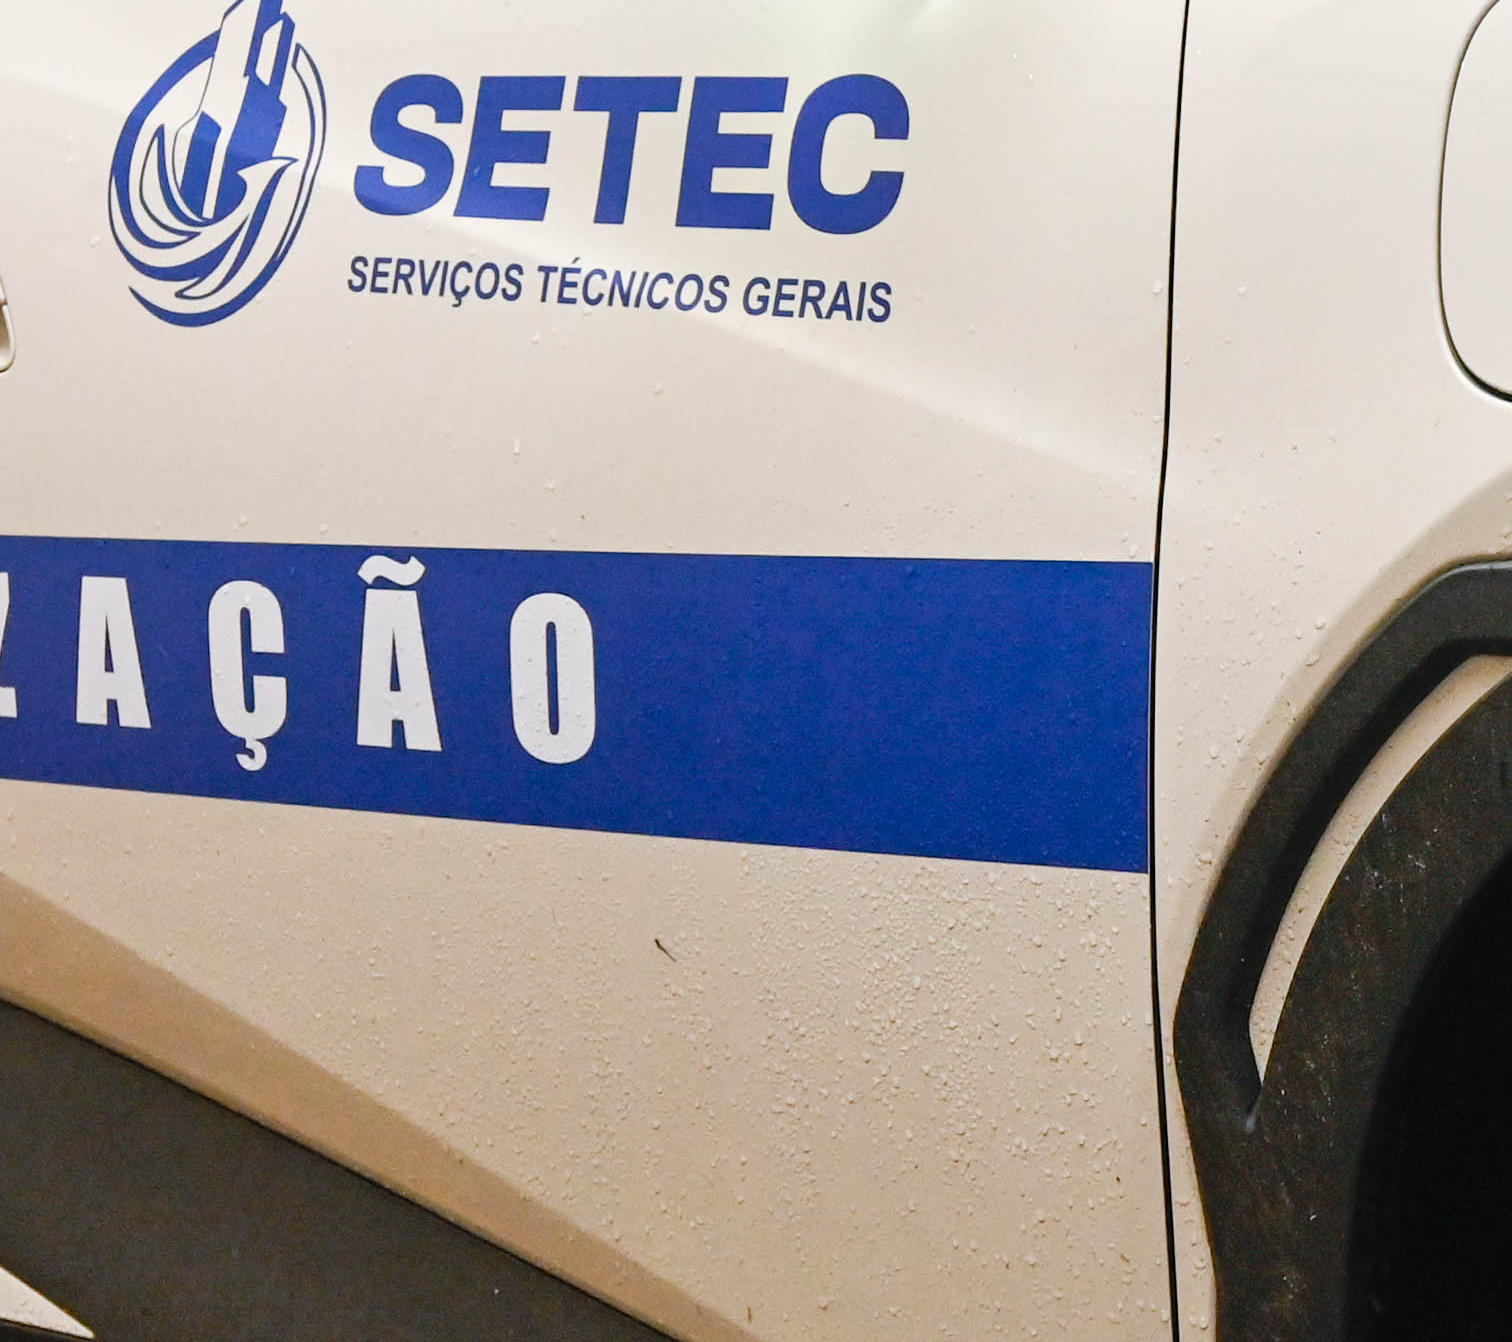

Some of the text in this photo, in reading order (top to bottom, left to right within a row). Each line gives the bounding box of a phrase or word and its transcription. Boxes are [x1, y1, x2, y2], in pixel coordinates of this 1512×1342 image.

[354, 73, 912, 236] SETEC
[347, 255, 893, 324] SERVIÇOS TÉCNICOS GERAIS
